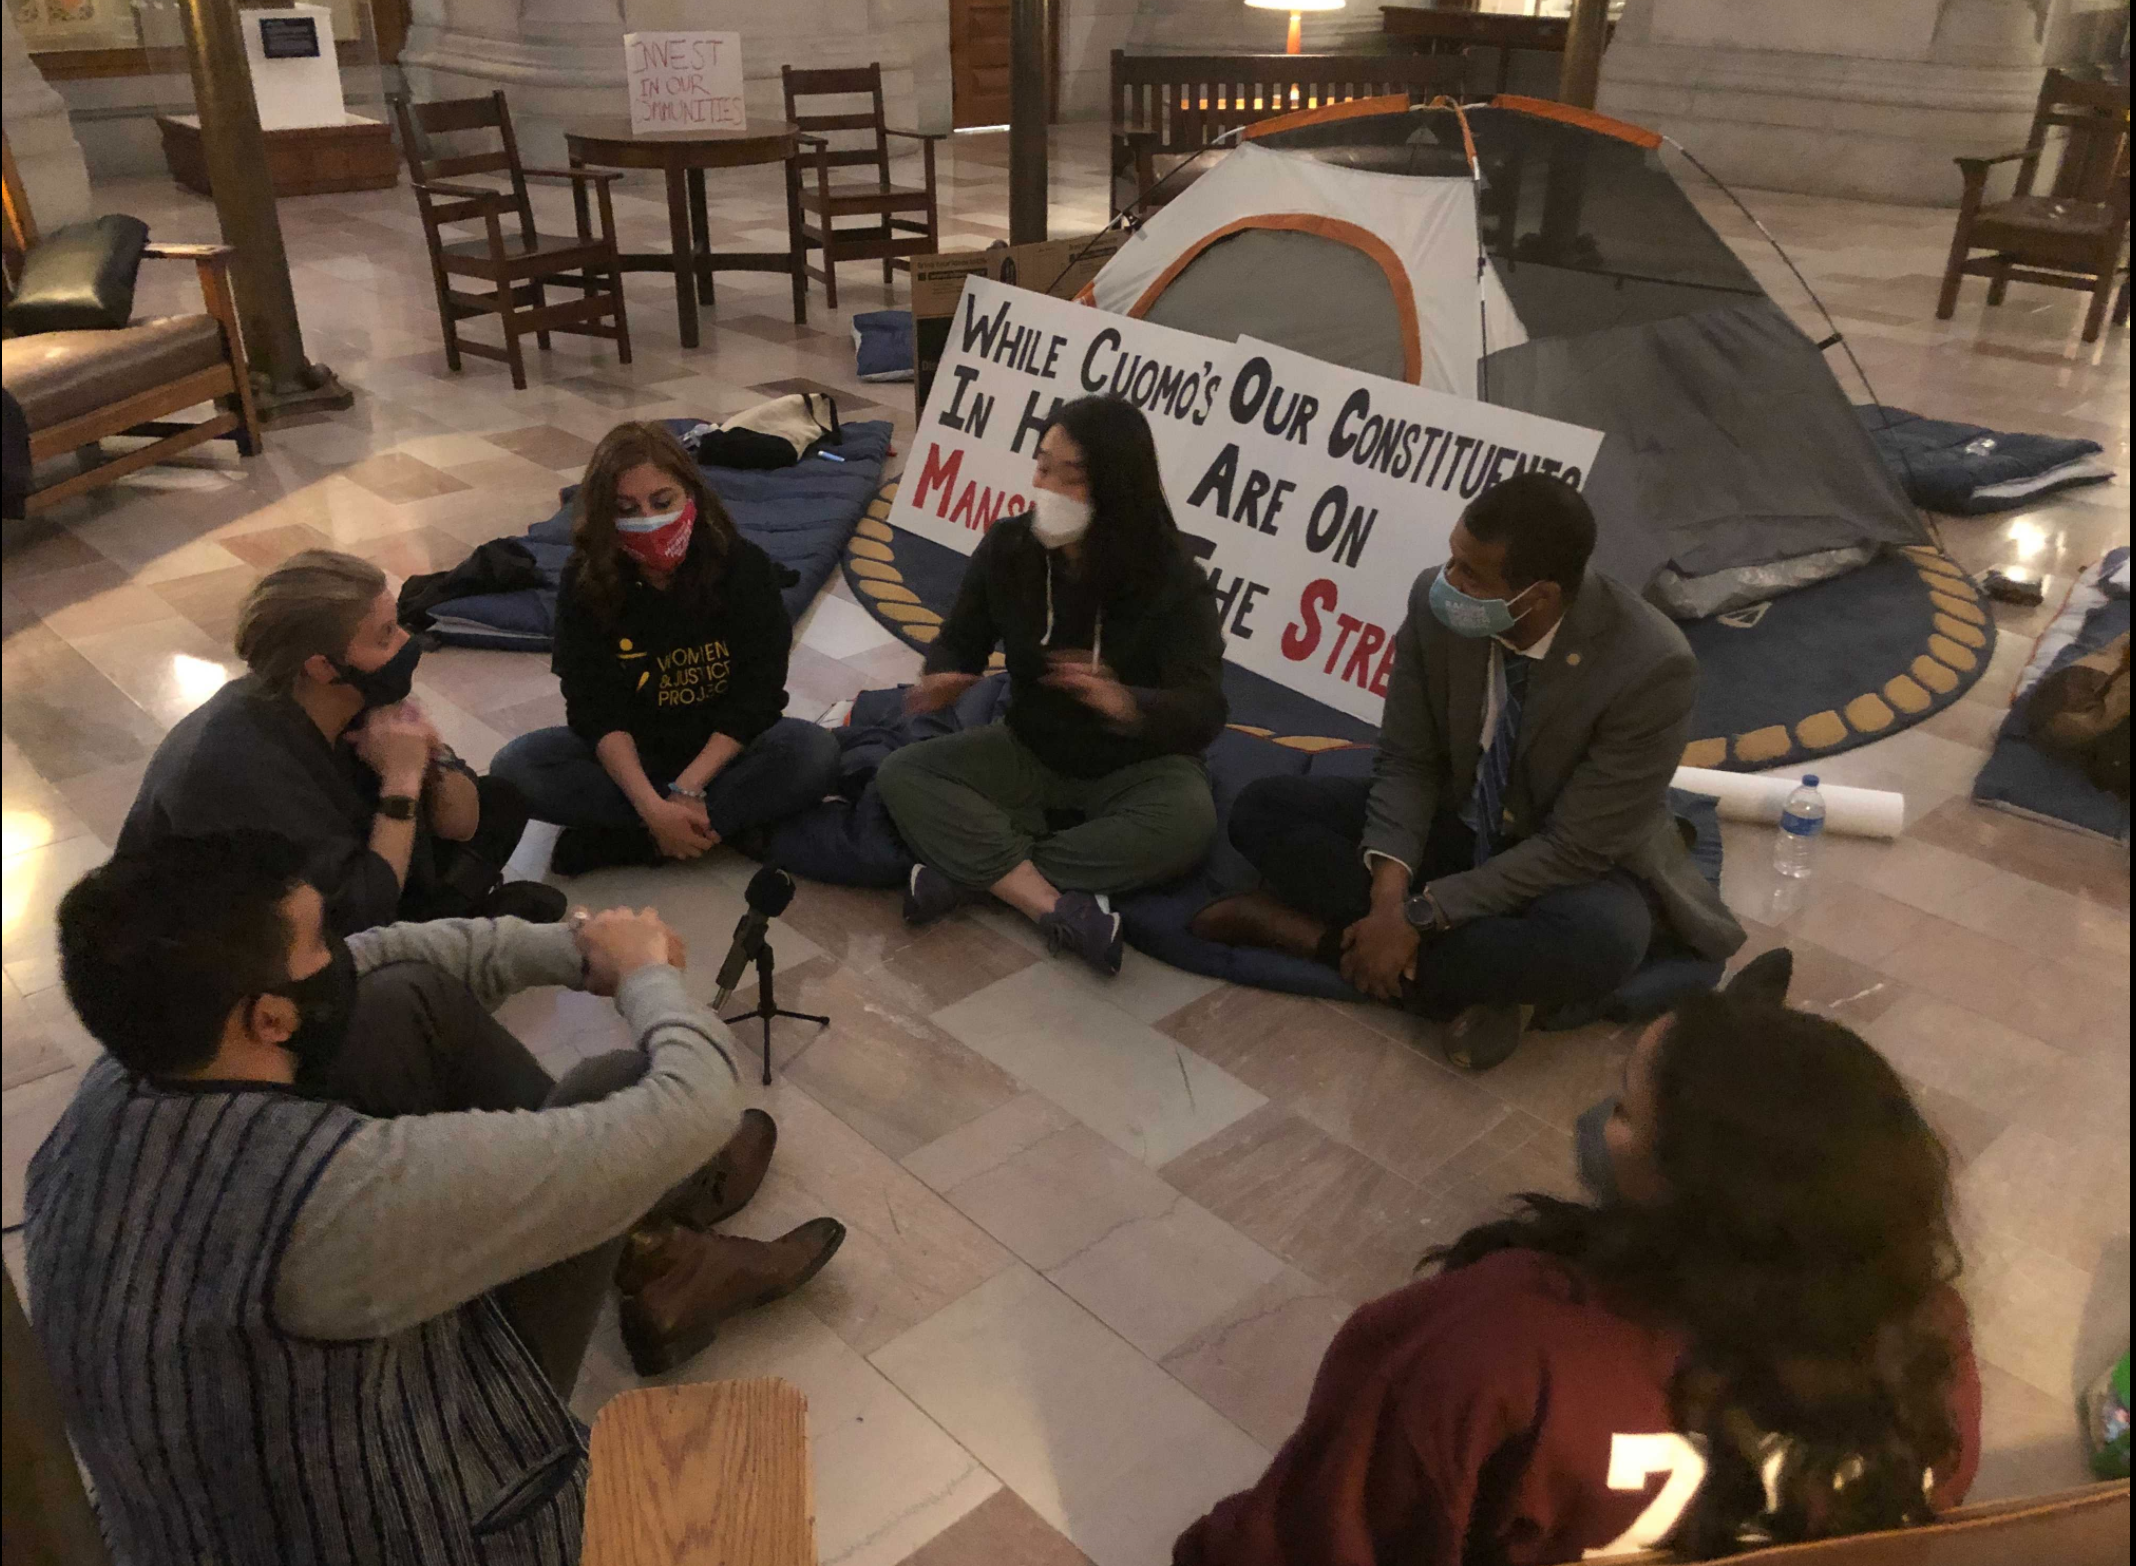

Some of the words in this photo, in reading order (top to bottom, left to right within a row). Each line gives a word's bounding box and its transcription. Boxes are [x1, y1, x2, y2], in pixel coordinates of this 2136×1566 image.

[631, 39, 723, 74] INVEST
[635, 97, 742, 126] OMMUNITIES
[641, 78, 659, 98] IN
[666, 74, 711, 95] OUR
[962, 293, 1068, 379] WHILE
[1080, 328, 1222, 426] CUOMO'S
[938, 364, 995, 439] IN
[1229, 356, 1319, 446] OUR
[1187, 443, 1296, 536] ARE
[1306, 485, 1379, 569] ON
[657, 641, 730, 673] WOMEN
